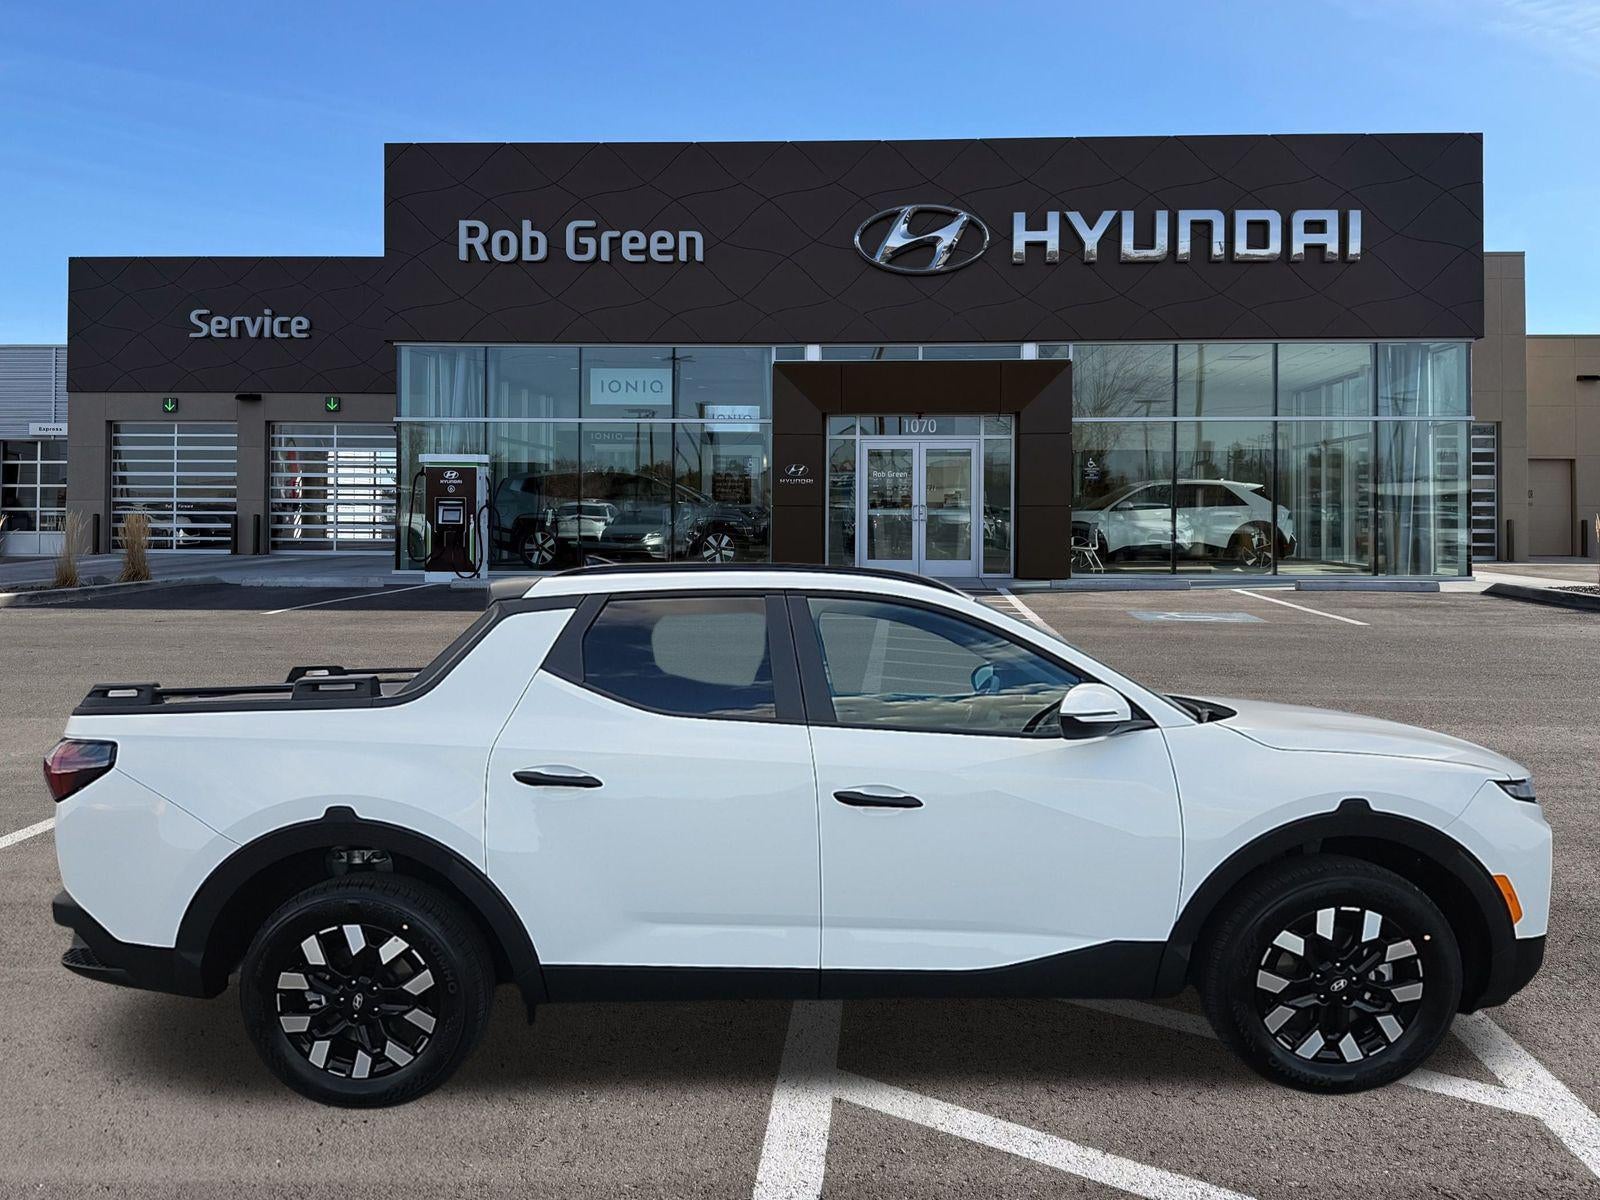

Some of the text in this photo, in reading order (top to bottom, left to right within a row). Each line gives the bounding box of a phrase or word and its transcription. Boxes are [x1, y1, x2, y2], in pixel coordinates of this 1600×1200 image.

[458, 219, 705, 263] Rob Green
[1011, 208, 1363, 264] HYUNDAI
[188, 308, 311, 338] Service
[600, 379, 664, 394] IONIQ
[903, 418, 937, 433] 1070
[591, 431, 624, 440] IONIQ
[872, 470, 908, 478] Rob Green
